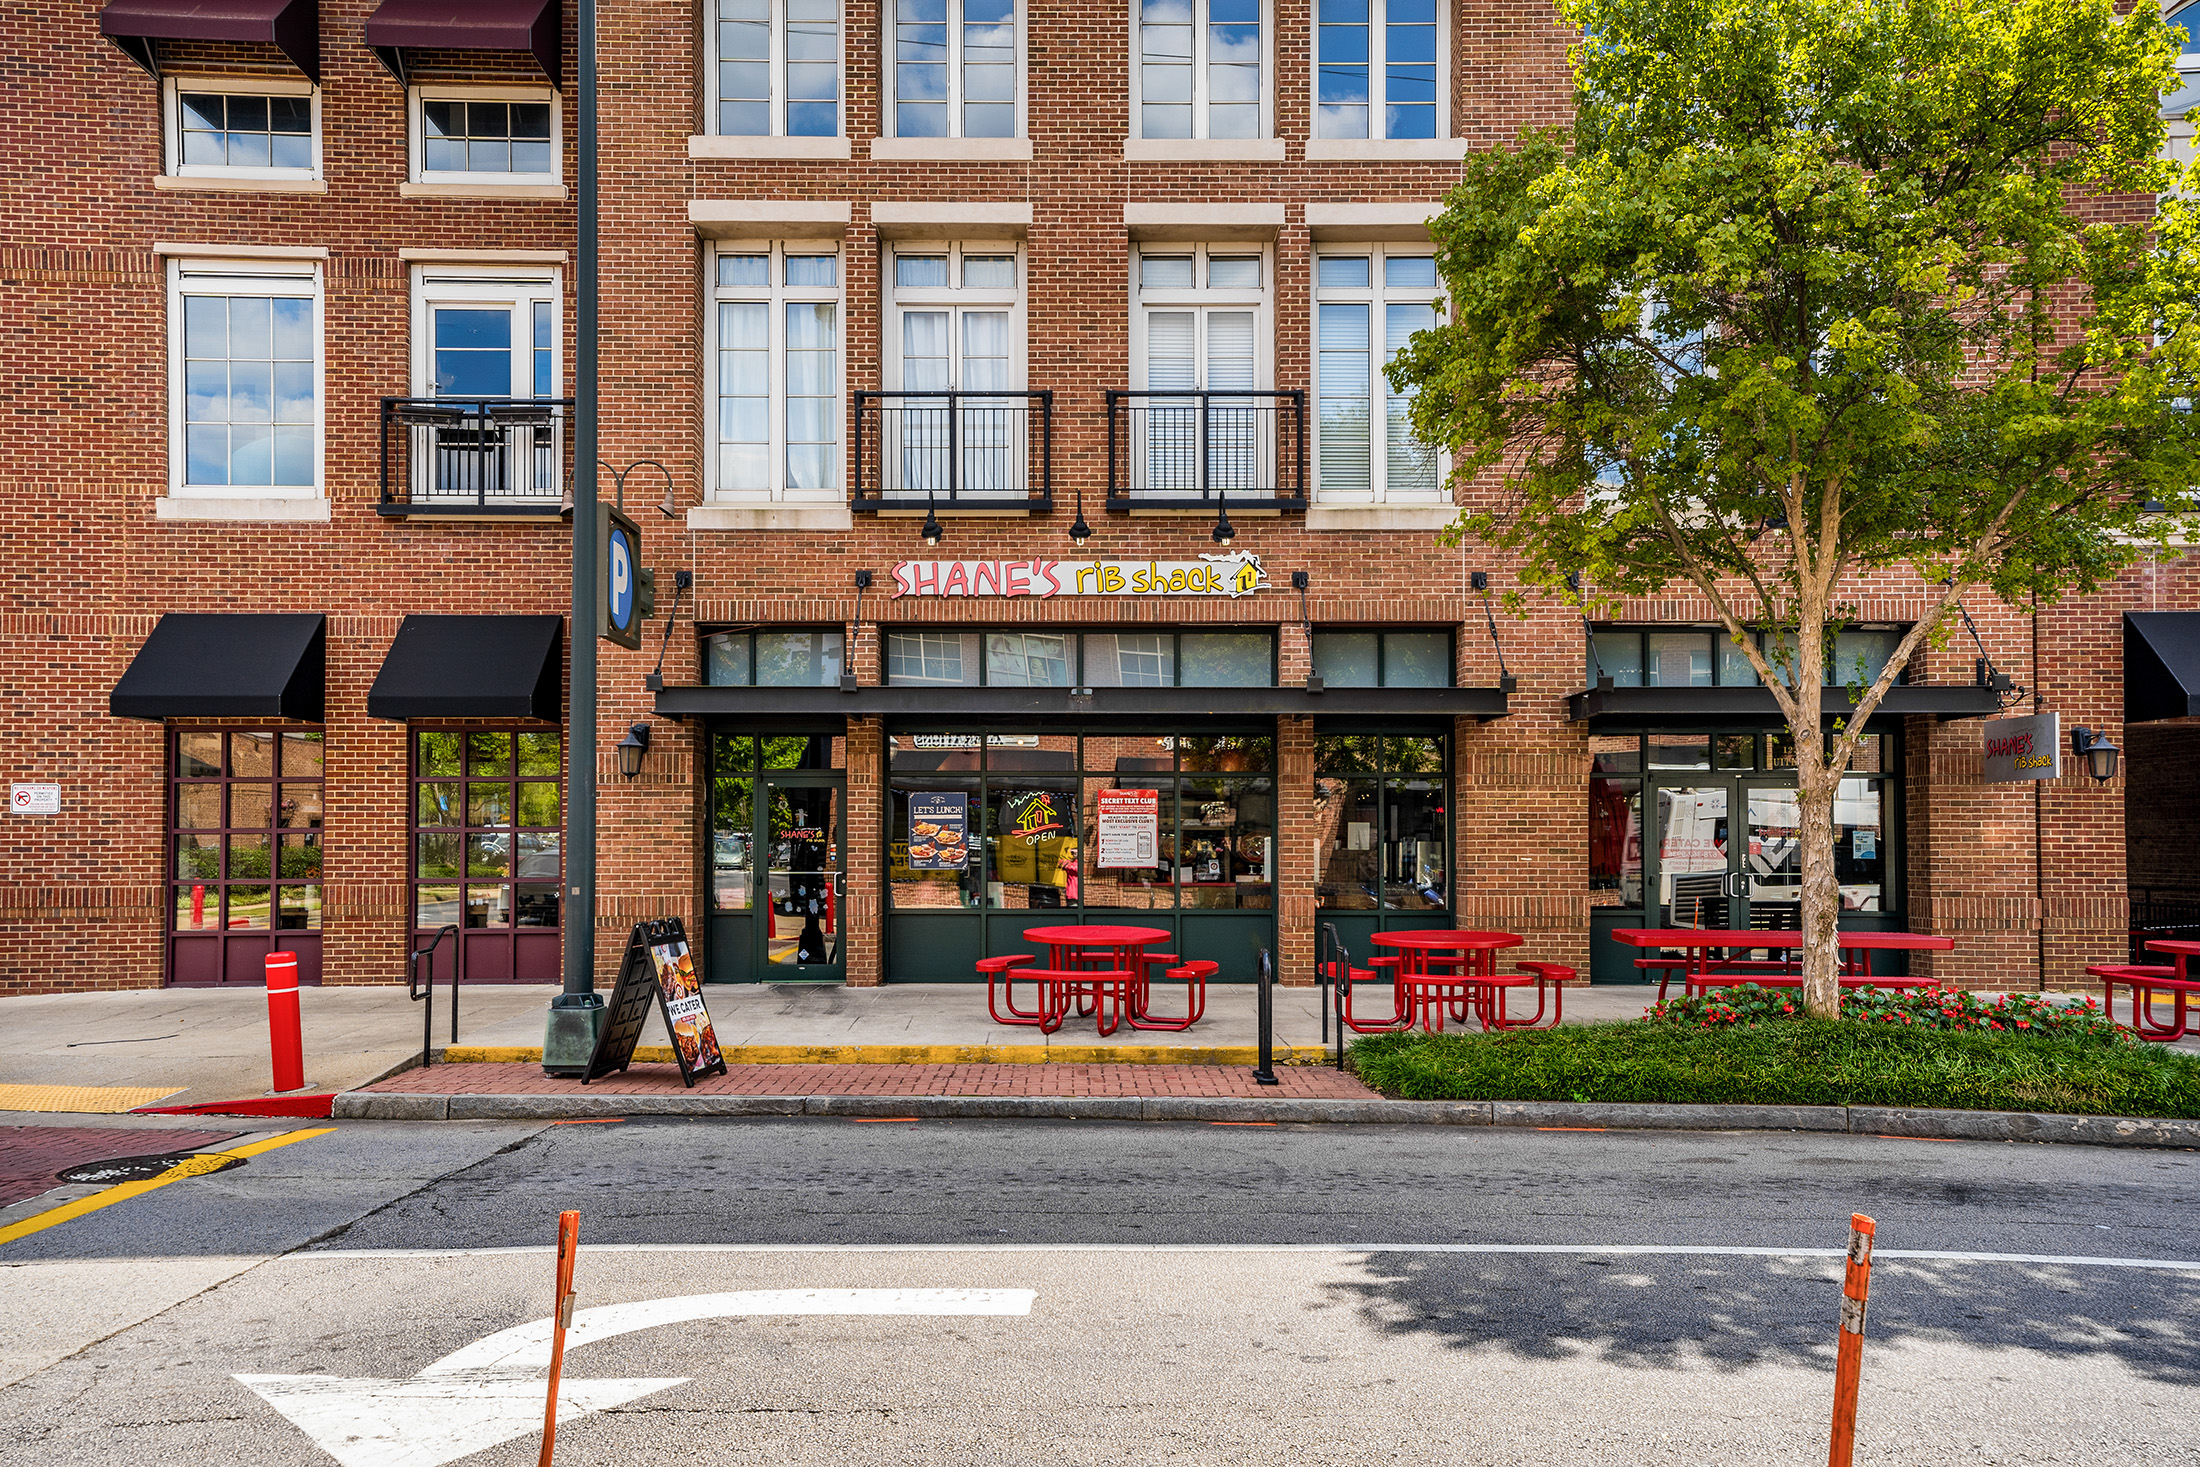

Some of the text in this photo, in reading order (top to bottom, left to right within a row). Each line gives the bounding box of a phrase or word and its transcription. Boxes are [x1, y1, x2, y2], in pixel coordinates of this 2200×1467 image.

[612, 540, 628, 615] P
[890, 556, 1061, 599] SHANE'S
[1132, 561, 1224, 593] shack
[1986, 733, 2034, 758] SHANE'S
[2028, 754, 2053, 768] shack
[913, 806, 963, 814] LET'S LUNCH!
[780, 830, 815, 839] SHANE'S
[1026, 830, 1056, 846] OPEN
[669, 999, 701, 1016] WE CATER
